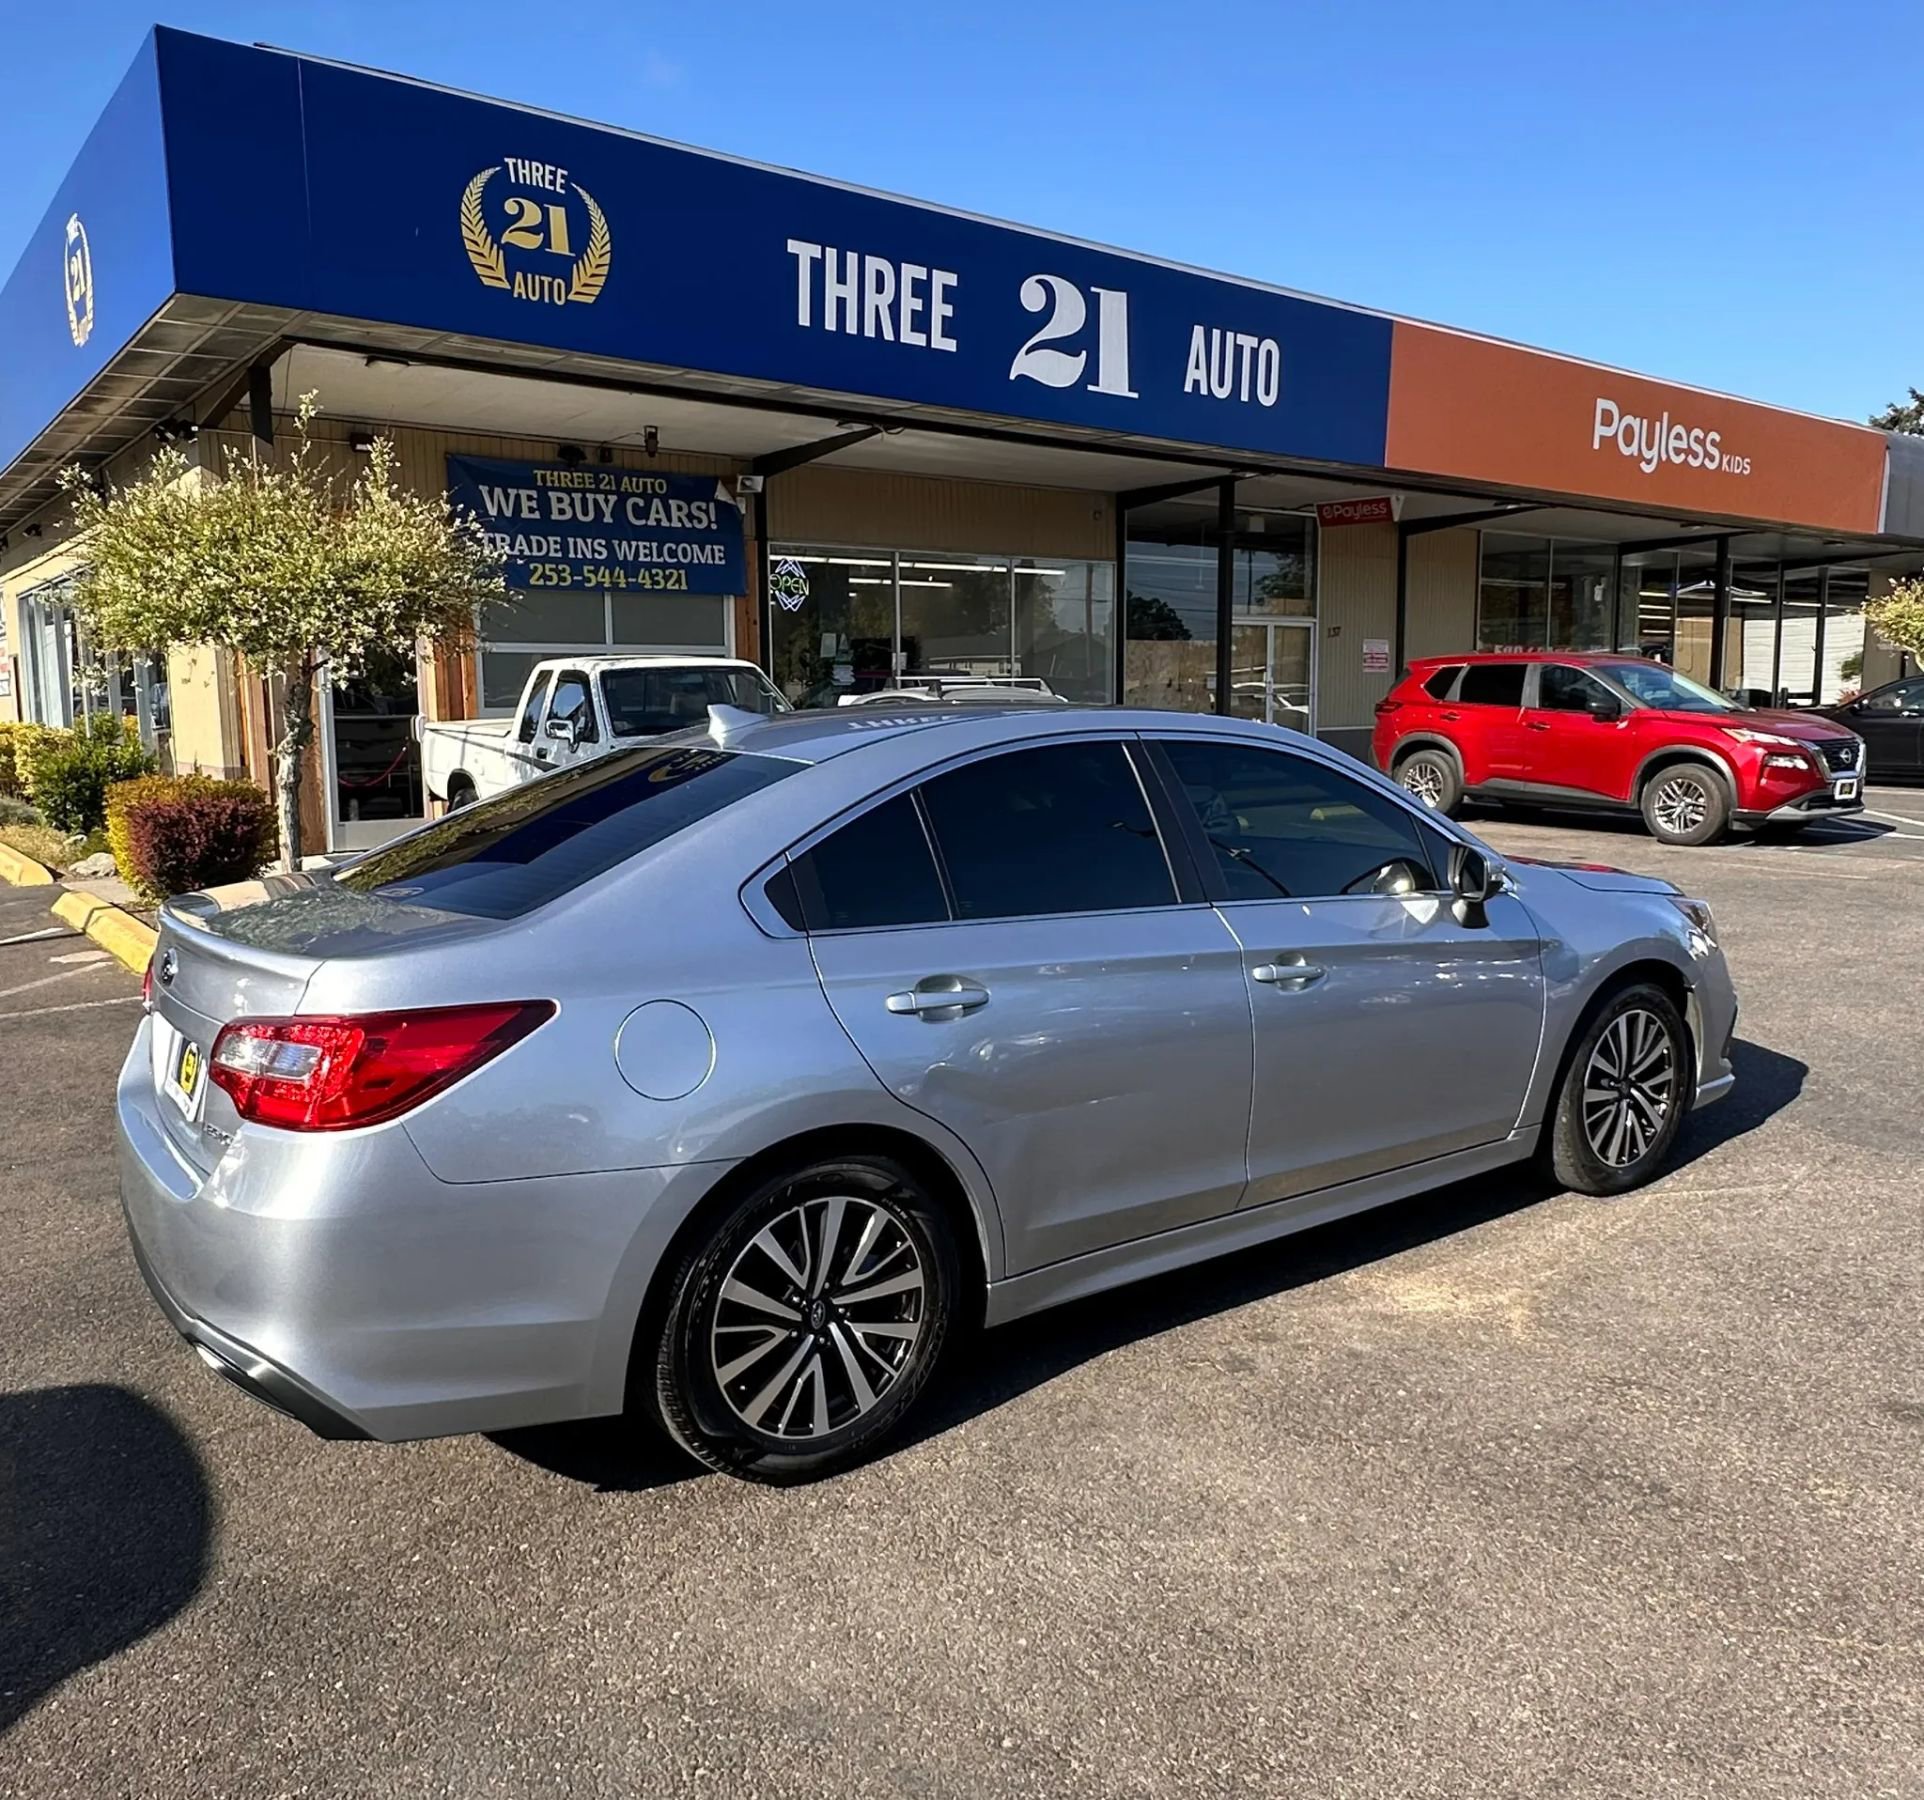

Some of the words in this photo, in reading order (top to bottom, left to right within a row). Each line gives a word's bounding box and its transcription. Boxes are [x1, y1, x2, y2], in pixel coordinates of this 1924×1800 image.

[504, 157, 568, 193] THREE
[501, 198, 576, 257] 21
[513, 271, 566, 306] AUTO
[787, 238, 958, 353] THREE
[1009, 274, 1140, 399] 21
[1183, 324, 1280, 407] AUTO
[1593, 397, 1721, 474] Payless
[1721, 453, 1751, 475] KIDS
[533, 469, 595, 490] THREE
[599, 473, 616, 490] 21
[620, 475, 667, 494] AUTO
[478, 485, 541, 520] WE
[547, 491, 616, 523] BUY
[625, 498, 718, 530] CARS!
[482, 532, 562, 557] TRADE
[567, 537, 608, 560] INS
[611, 540, 726, 565] WELCOME
[529, 563, 688, 590] 253-544-4321
